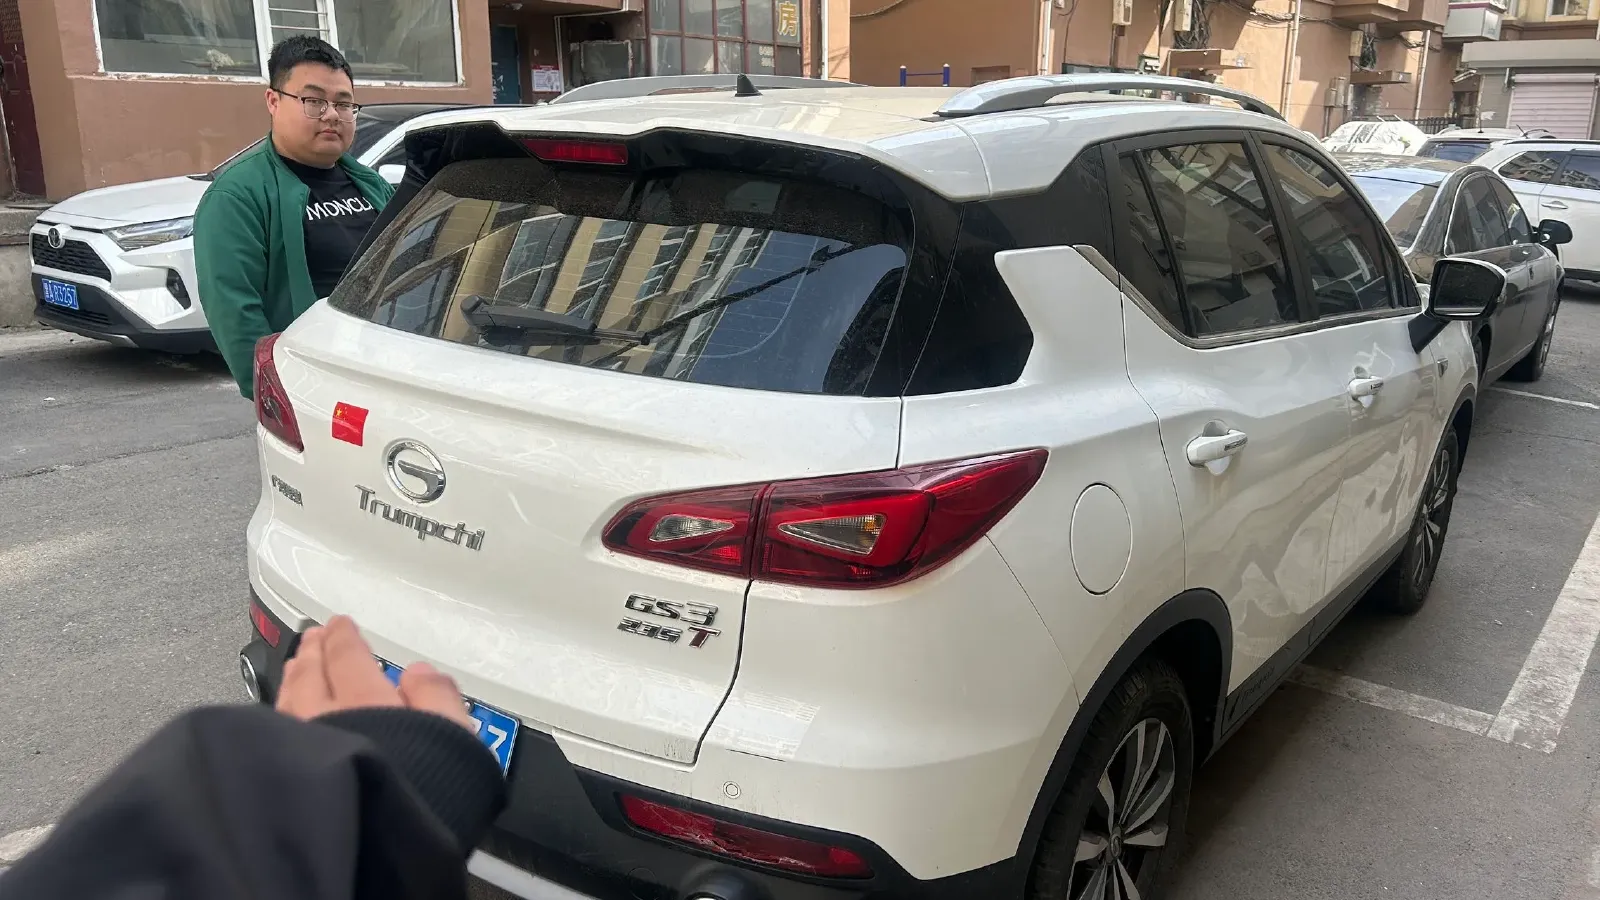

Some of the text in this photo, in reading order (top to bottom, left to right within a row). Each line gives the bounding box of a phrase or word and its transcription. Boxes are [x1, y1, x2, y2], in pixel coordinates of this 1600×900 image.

[777, 1, 798, 37] 房
[355, 484, 486, 551] Trumpchi
[624, 593, 719, 626] GS3
